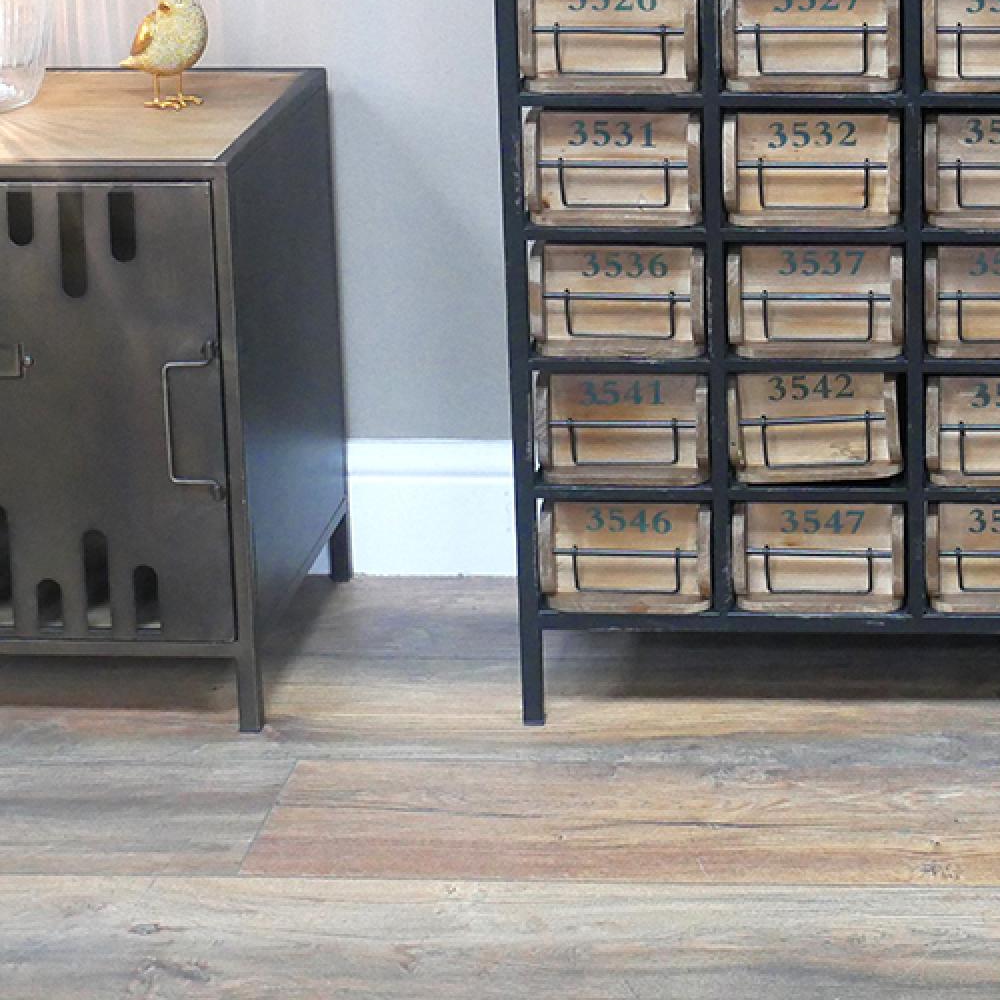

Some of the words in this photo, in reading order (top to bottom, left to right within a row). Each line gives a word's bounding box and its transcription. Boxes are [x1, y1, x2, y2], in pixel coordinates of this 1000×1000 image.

[568, 119, 656, 148] 3531
[767, 121, 858, 149] 3532
[581, 251, 667, 279] 3536
[778, 248, 866, 276] 3537
[578, 379, 665, 406] 3541
[767, 373, 855, 402] 3542
[586, 506, 672, 534] 3546
[779, 508, 865, 535] 3547
